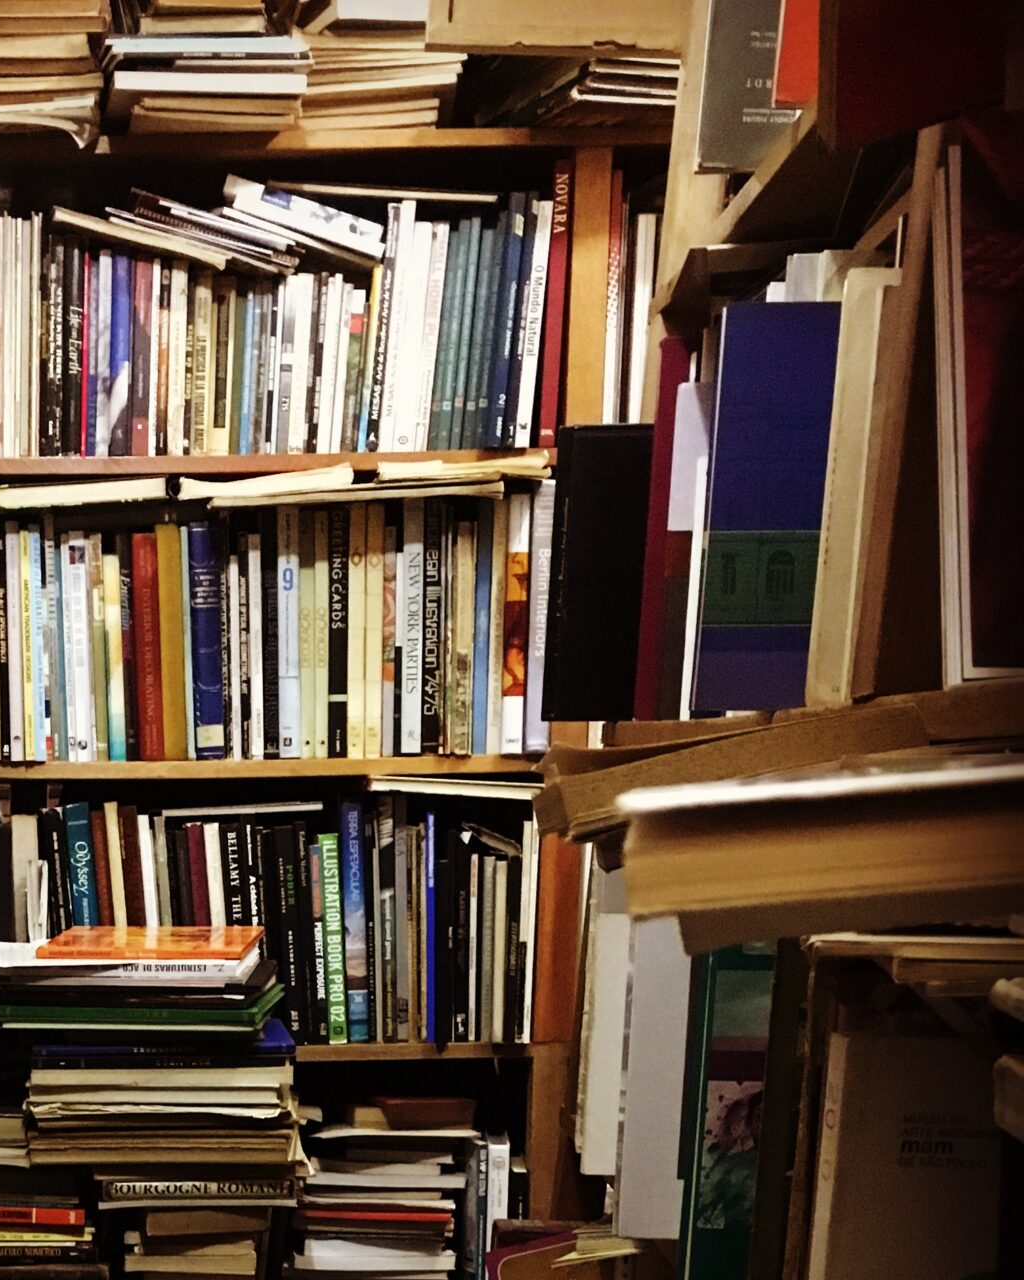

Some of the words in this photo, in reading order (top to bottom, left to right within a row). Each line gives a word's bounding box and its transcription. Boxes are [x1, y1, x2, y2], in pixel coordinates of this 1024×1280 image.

[553, 173, 570, 235] NOVARA
[529, 276, 544, 312] Mundo
[67, 305, 83, 327] Life
[67, 338, 82, 375] Earth
[525, 317, 540, 357] Natural
[408, 551, 422, 591] NEW
[535, 547, 552, 591] Berlin
[330, 583, 343, 629] CARDS
[407, 593, 421, 632] YORK
[534, 593, 549, 657] Interiors
[405, 637, 419, 695] PARTIES
[70, 841, 91, 897] Odyssey
[226, 831, 241, 887] BELLAMY
[231, 894, 243, 920] THE
[314, 921, 324, 957] PERFECT
[327, 934, 342, 973] BOOK
[141, 963, 152, 973] DE
[154, 963, 207, 973] ESTRUTURAS
[315, 958, 326, 1000] EXPOSURE
[328, 975, 343, 1001] PRO
[330, 1005, 345, 1022] 02
[901, 1140, 954, 1154] mam
